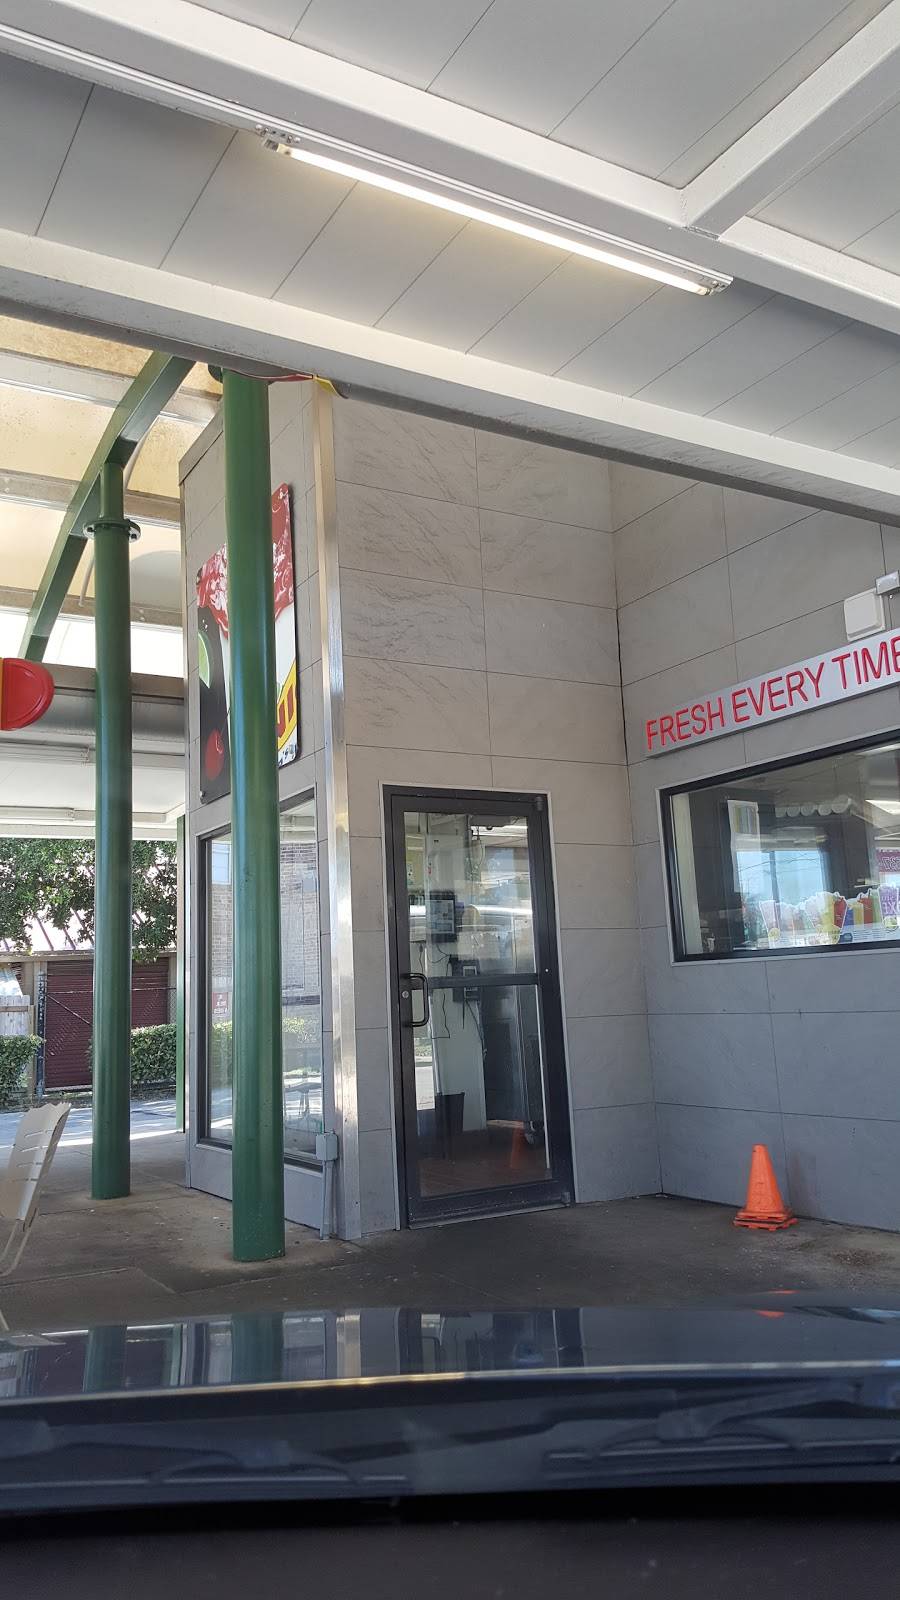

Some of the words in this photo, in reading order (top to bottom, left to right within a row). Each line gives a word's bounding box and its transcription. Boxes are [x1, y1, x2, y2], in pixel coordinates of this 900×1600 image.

[646, 697, 725, 750] FRESH
[731, 662, 825, 723] EVERY
[831, 635, 900, 690] TIME
